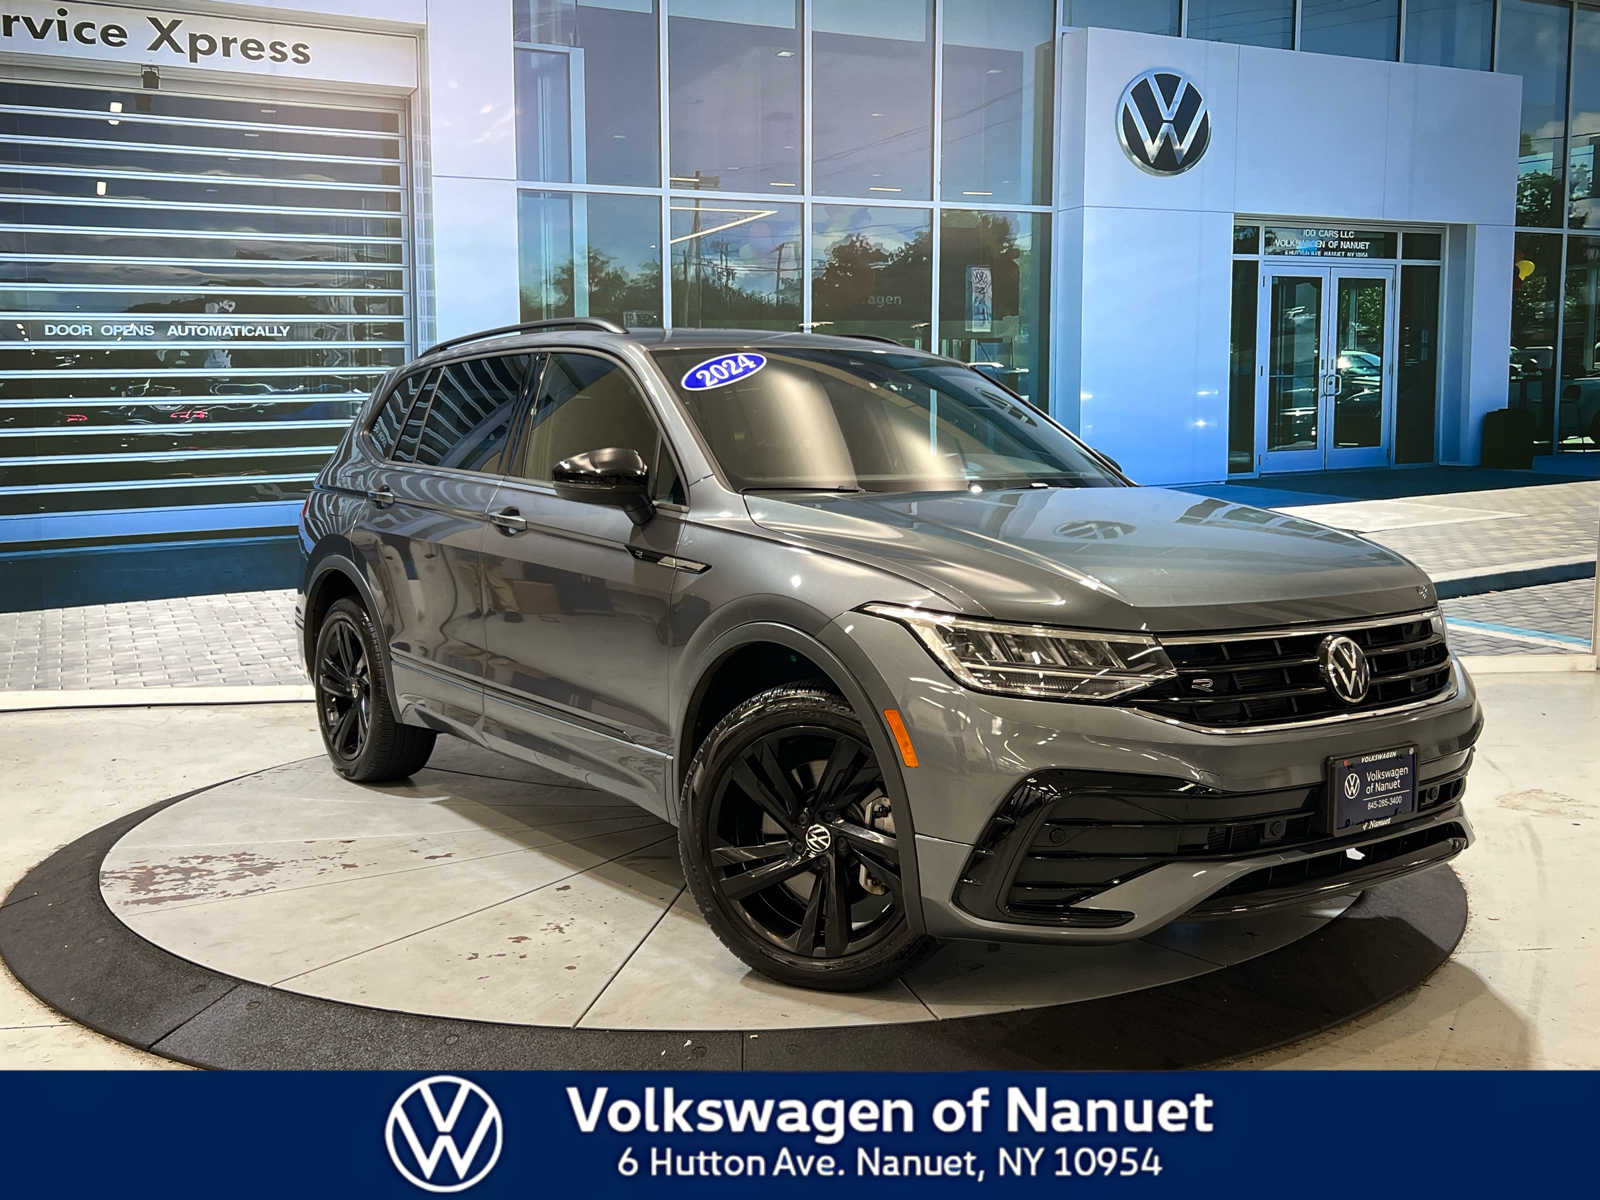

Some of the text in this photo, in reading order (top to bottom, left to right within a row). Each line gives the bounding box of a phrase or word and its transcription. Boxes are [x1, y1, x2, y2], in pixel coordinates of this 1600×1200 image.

[146, 16, 312, 64] Xpress
[1318, 229, 1339, 239] CARS
[1340, 230, 1355, 239] LLC
[1328, 240, 1339, 249] OF
[1340, 240, 1371, 250] NANUET
[44, 324, 290, 337] DOOR OPENS AUTOMATICALLY
[696, 355, 757, 387] 2024
[1361, 751, 1397, 763] VOLKSWAGEN
[1366, 767, 1409, 782] Volkswagen
[1365, 779, 1401, 794] of Nanuet
